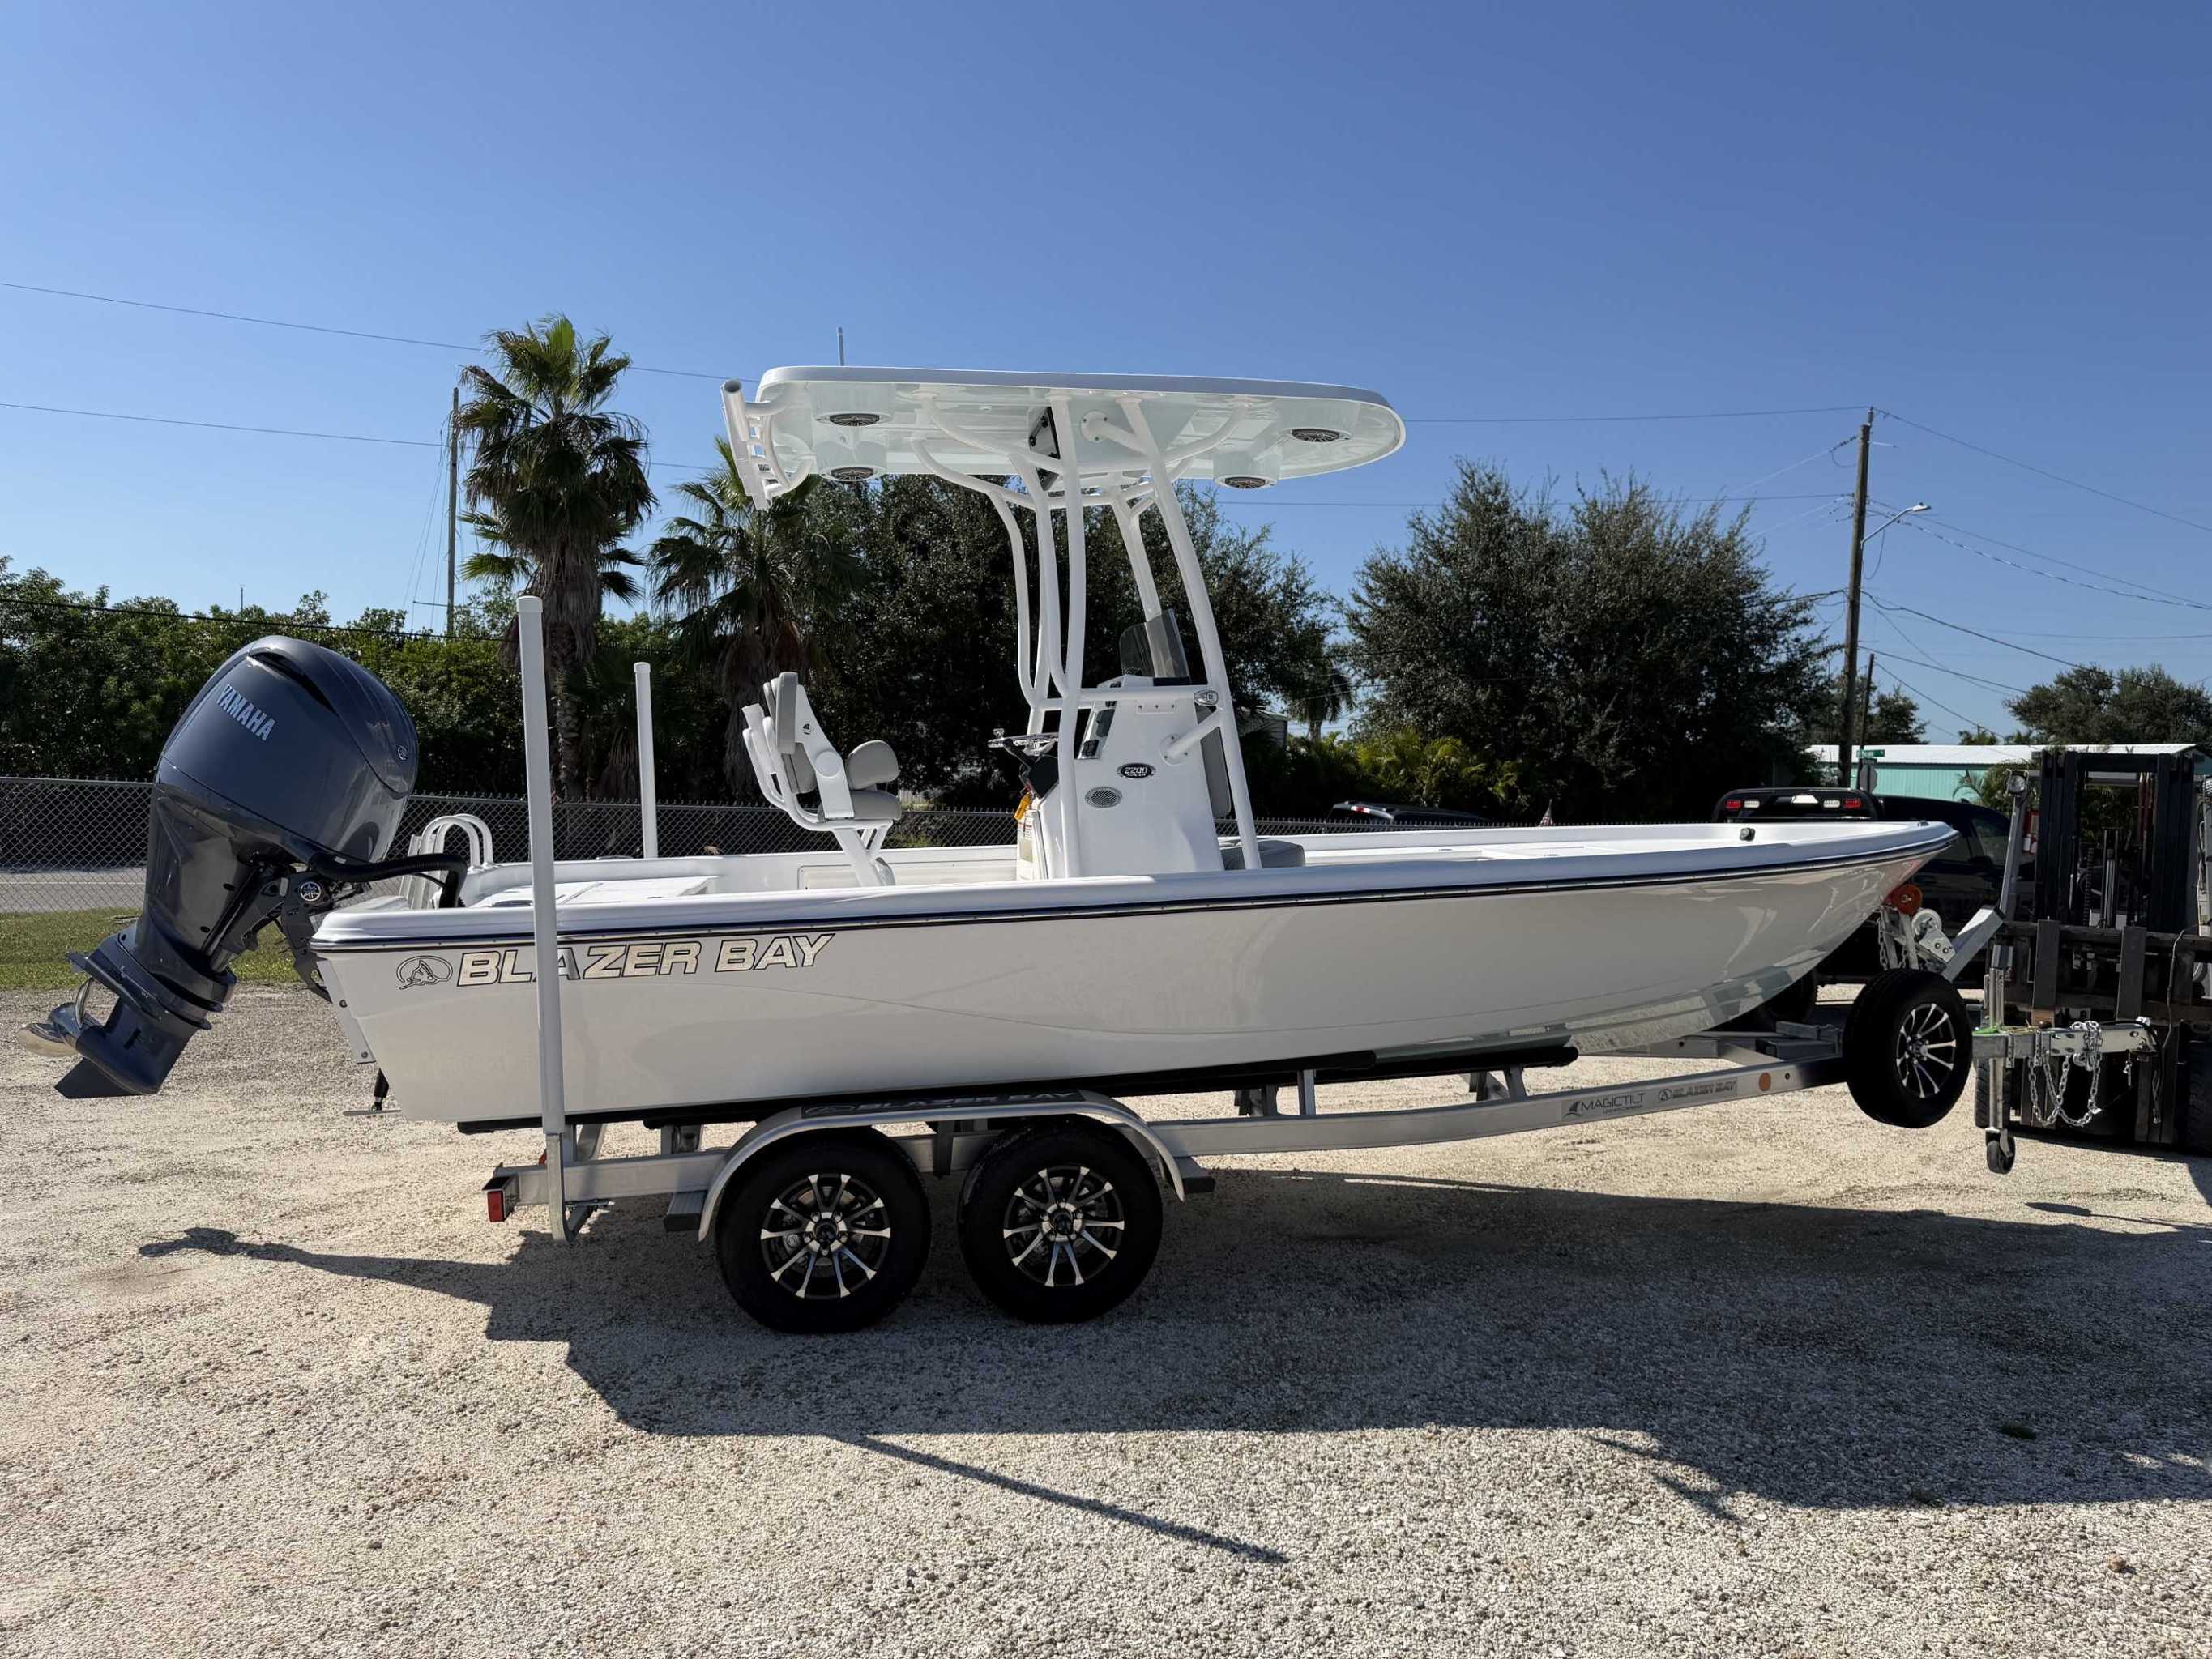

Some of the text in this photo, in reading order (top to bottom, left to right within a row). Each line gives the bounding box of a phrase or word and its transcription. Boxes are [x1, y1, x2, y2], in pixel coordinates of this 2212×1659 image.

[216, 684, 275, 740] YAMAHA
[715, 933, 836, 972] BAY
[1581, 1092, 1646, 1111] MAGICTILT
